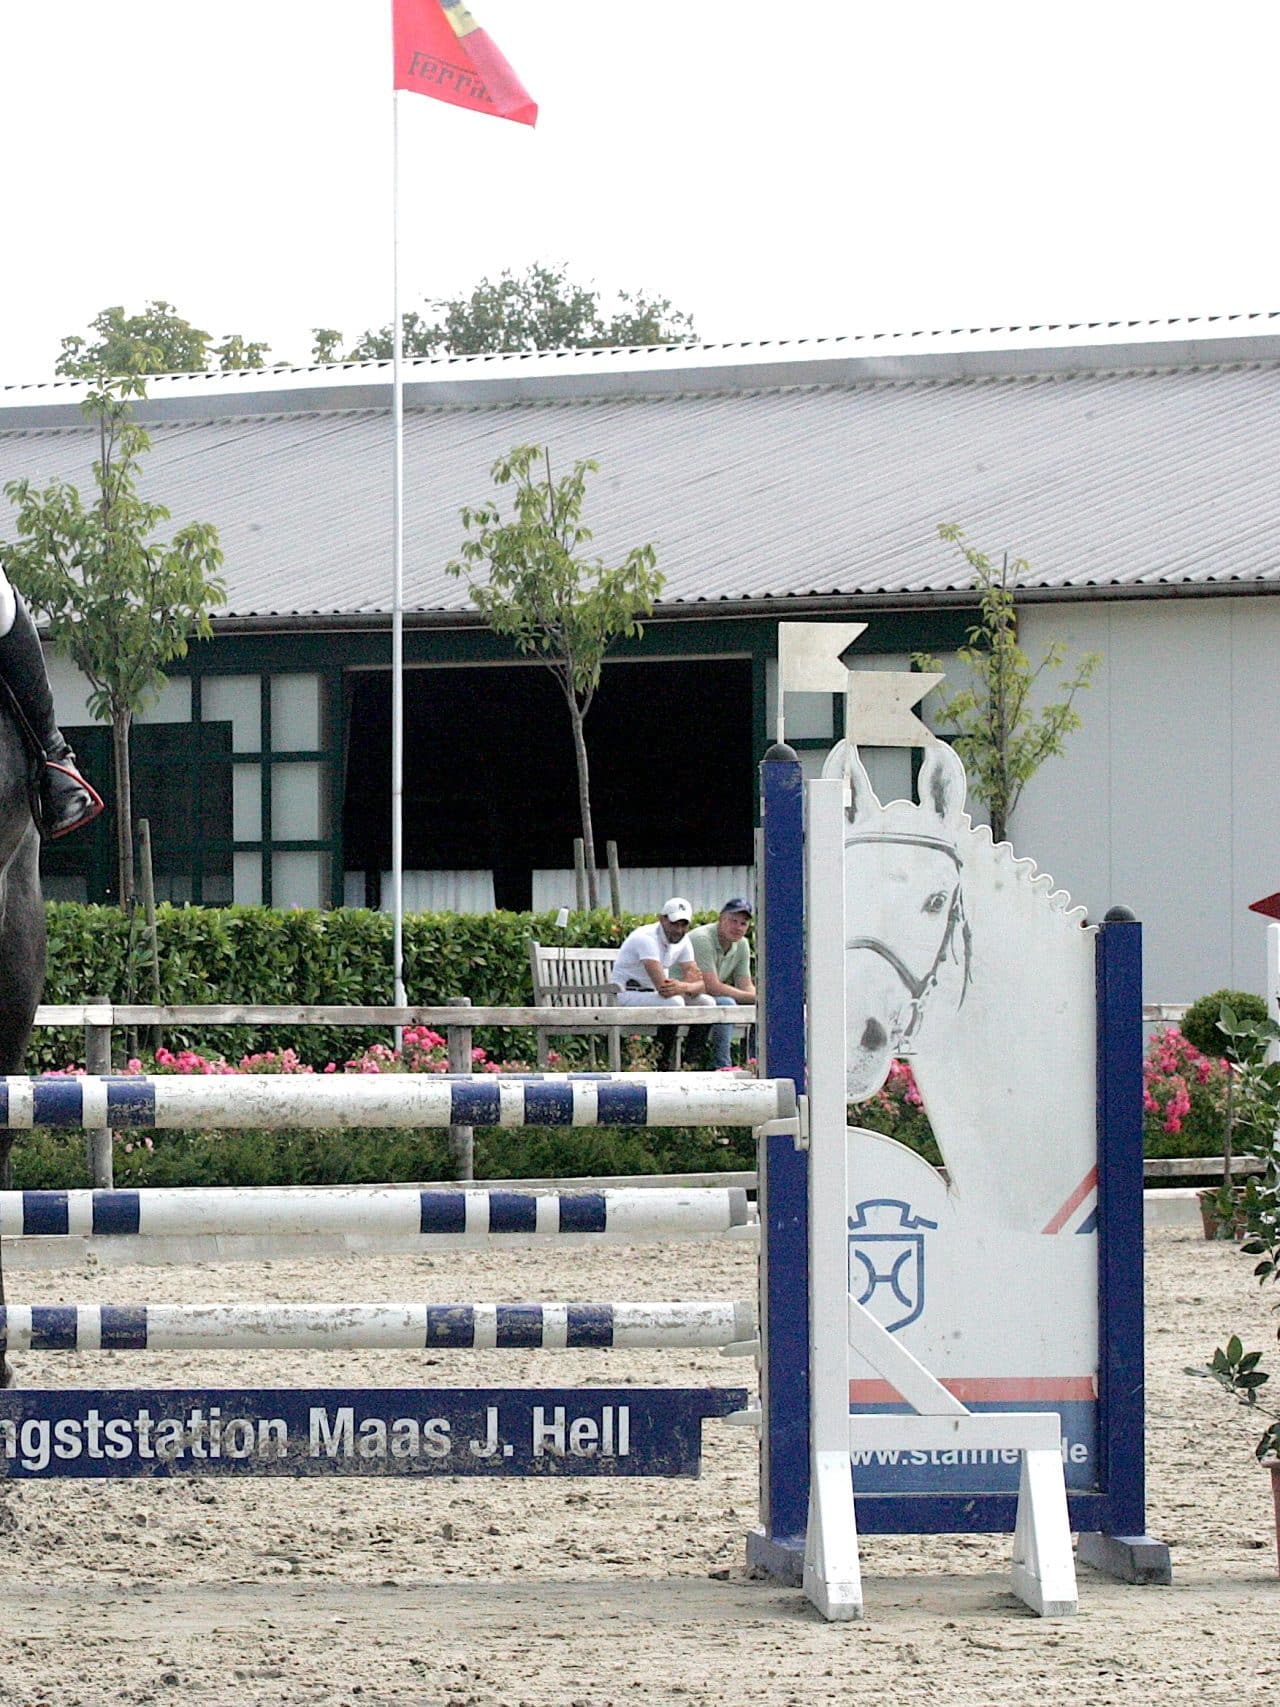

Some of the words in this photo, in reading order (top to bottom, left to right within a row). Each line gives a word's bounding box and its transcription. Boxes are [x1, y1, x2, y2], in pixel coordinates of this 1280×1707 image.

[408, 51, 493, 103] Ferra
[310, 1406, 452, 1458] Maas
[468, 1407, 515, 1458] J.
[532, 1406, 632, 1457] Hell
